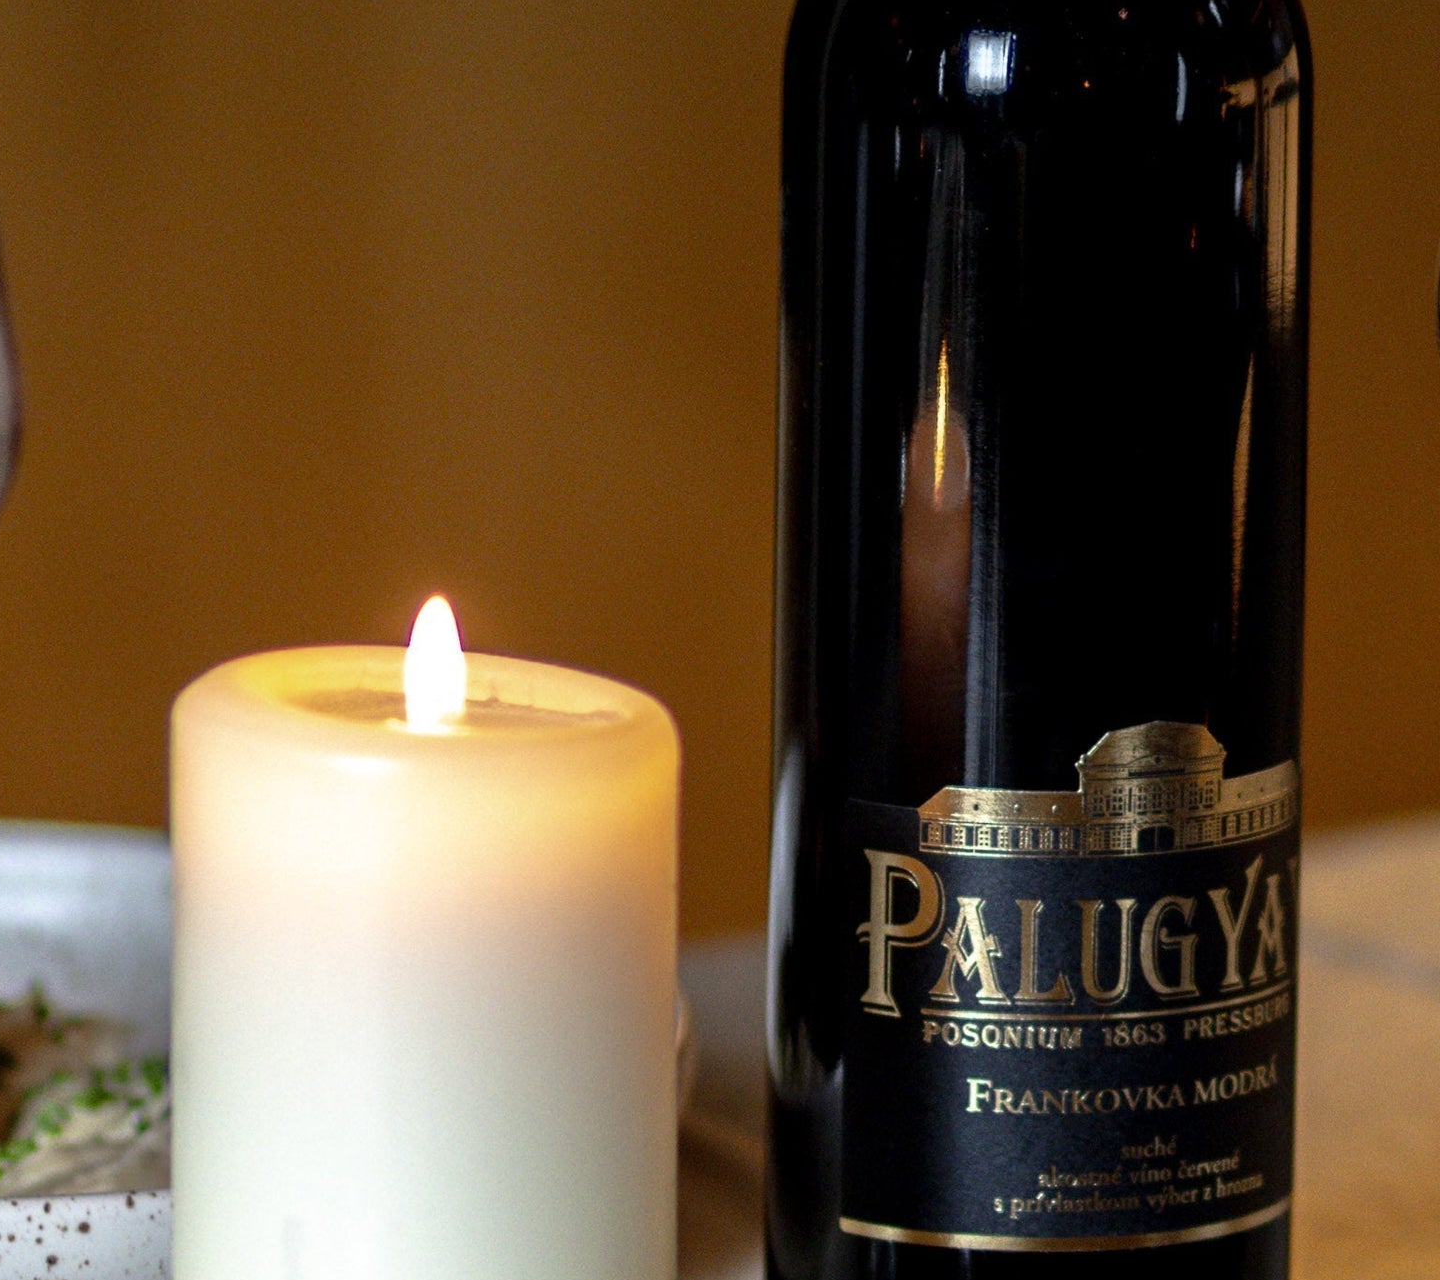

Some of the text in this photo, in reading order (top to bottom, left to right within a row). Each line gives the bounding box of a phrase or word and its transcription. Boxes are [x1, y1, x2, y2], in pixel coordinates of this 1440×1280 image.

[855, 848, 1298, 1017] PALUGYA
[922, 1020, 1082, 1050] POSONIUM
[1102, 1021, 1167, 1048] 1863
[966, 1054, 1278, 1114] FRANKOVKA MODRÁ
[1120, 1135, 1177, 1159] suché
[993, 1196, 1004, 1214] s
